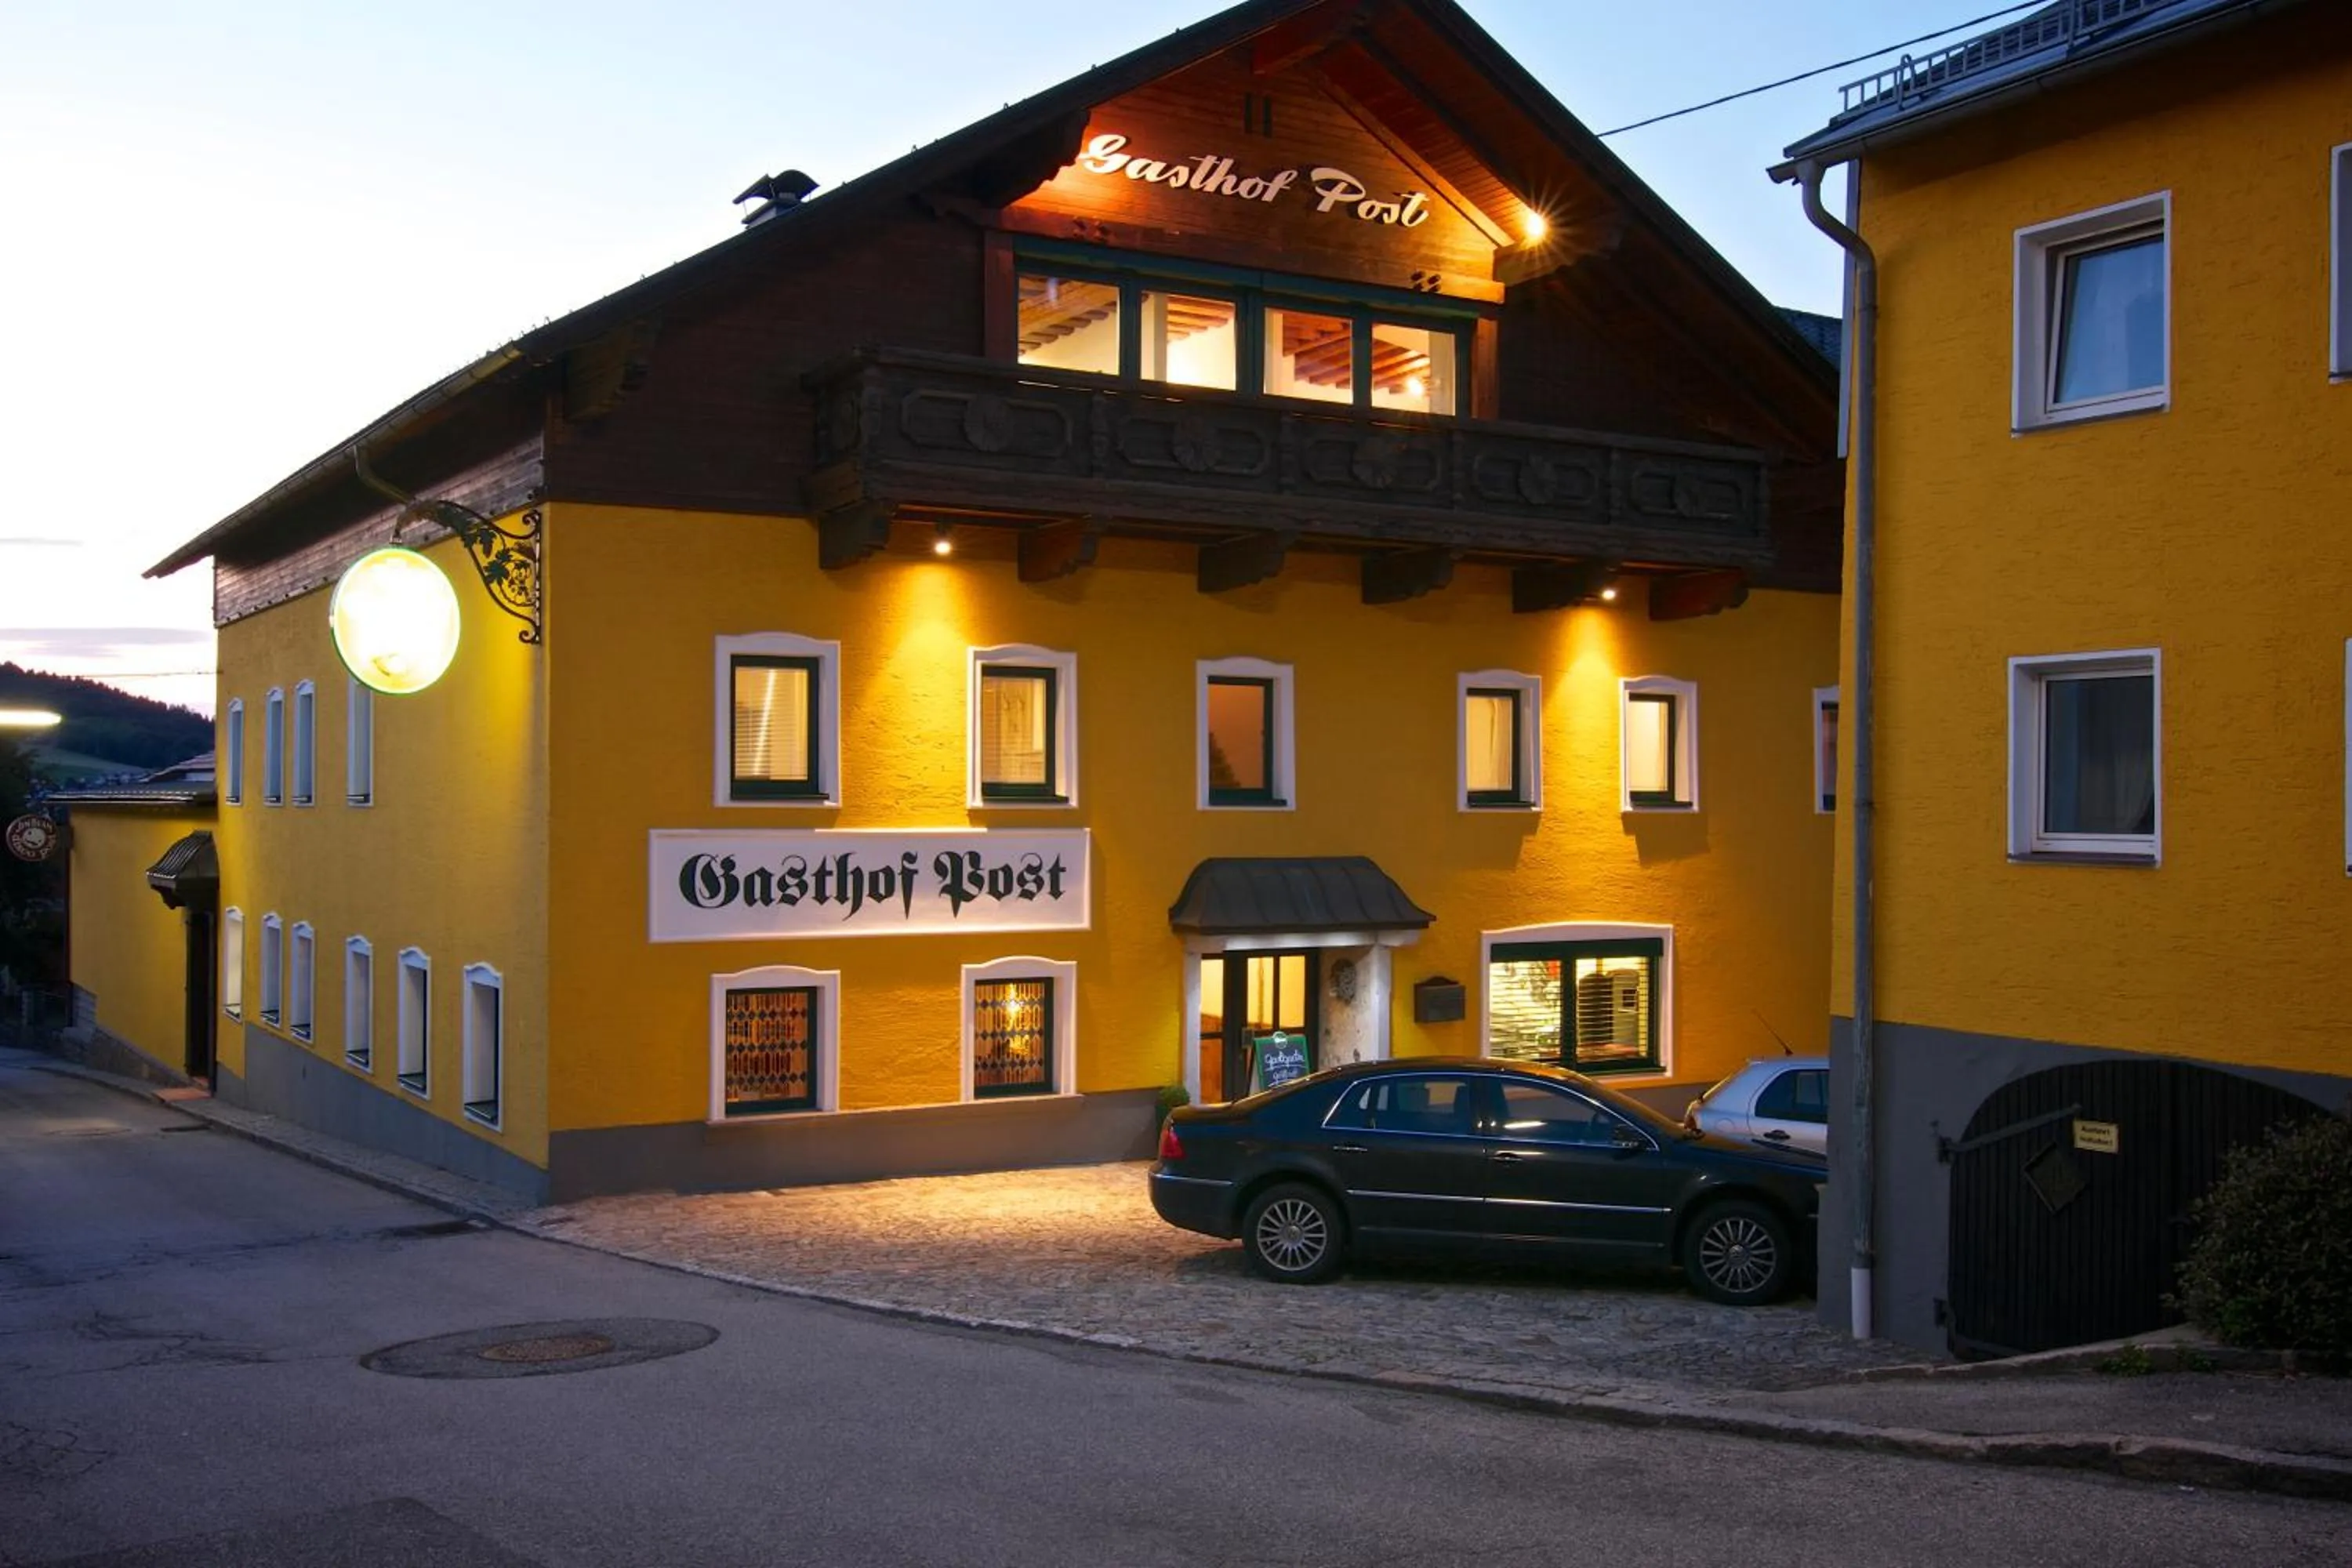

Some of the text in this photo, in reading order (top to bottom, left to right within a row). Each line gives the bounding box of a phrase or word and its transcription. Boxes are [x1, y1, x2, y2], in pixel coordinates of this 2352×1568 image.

[1079, 134, 1430, 227] Gasthof Post
[679, 851, 1067, 921] Gasthof Post
